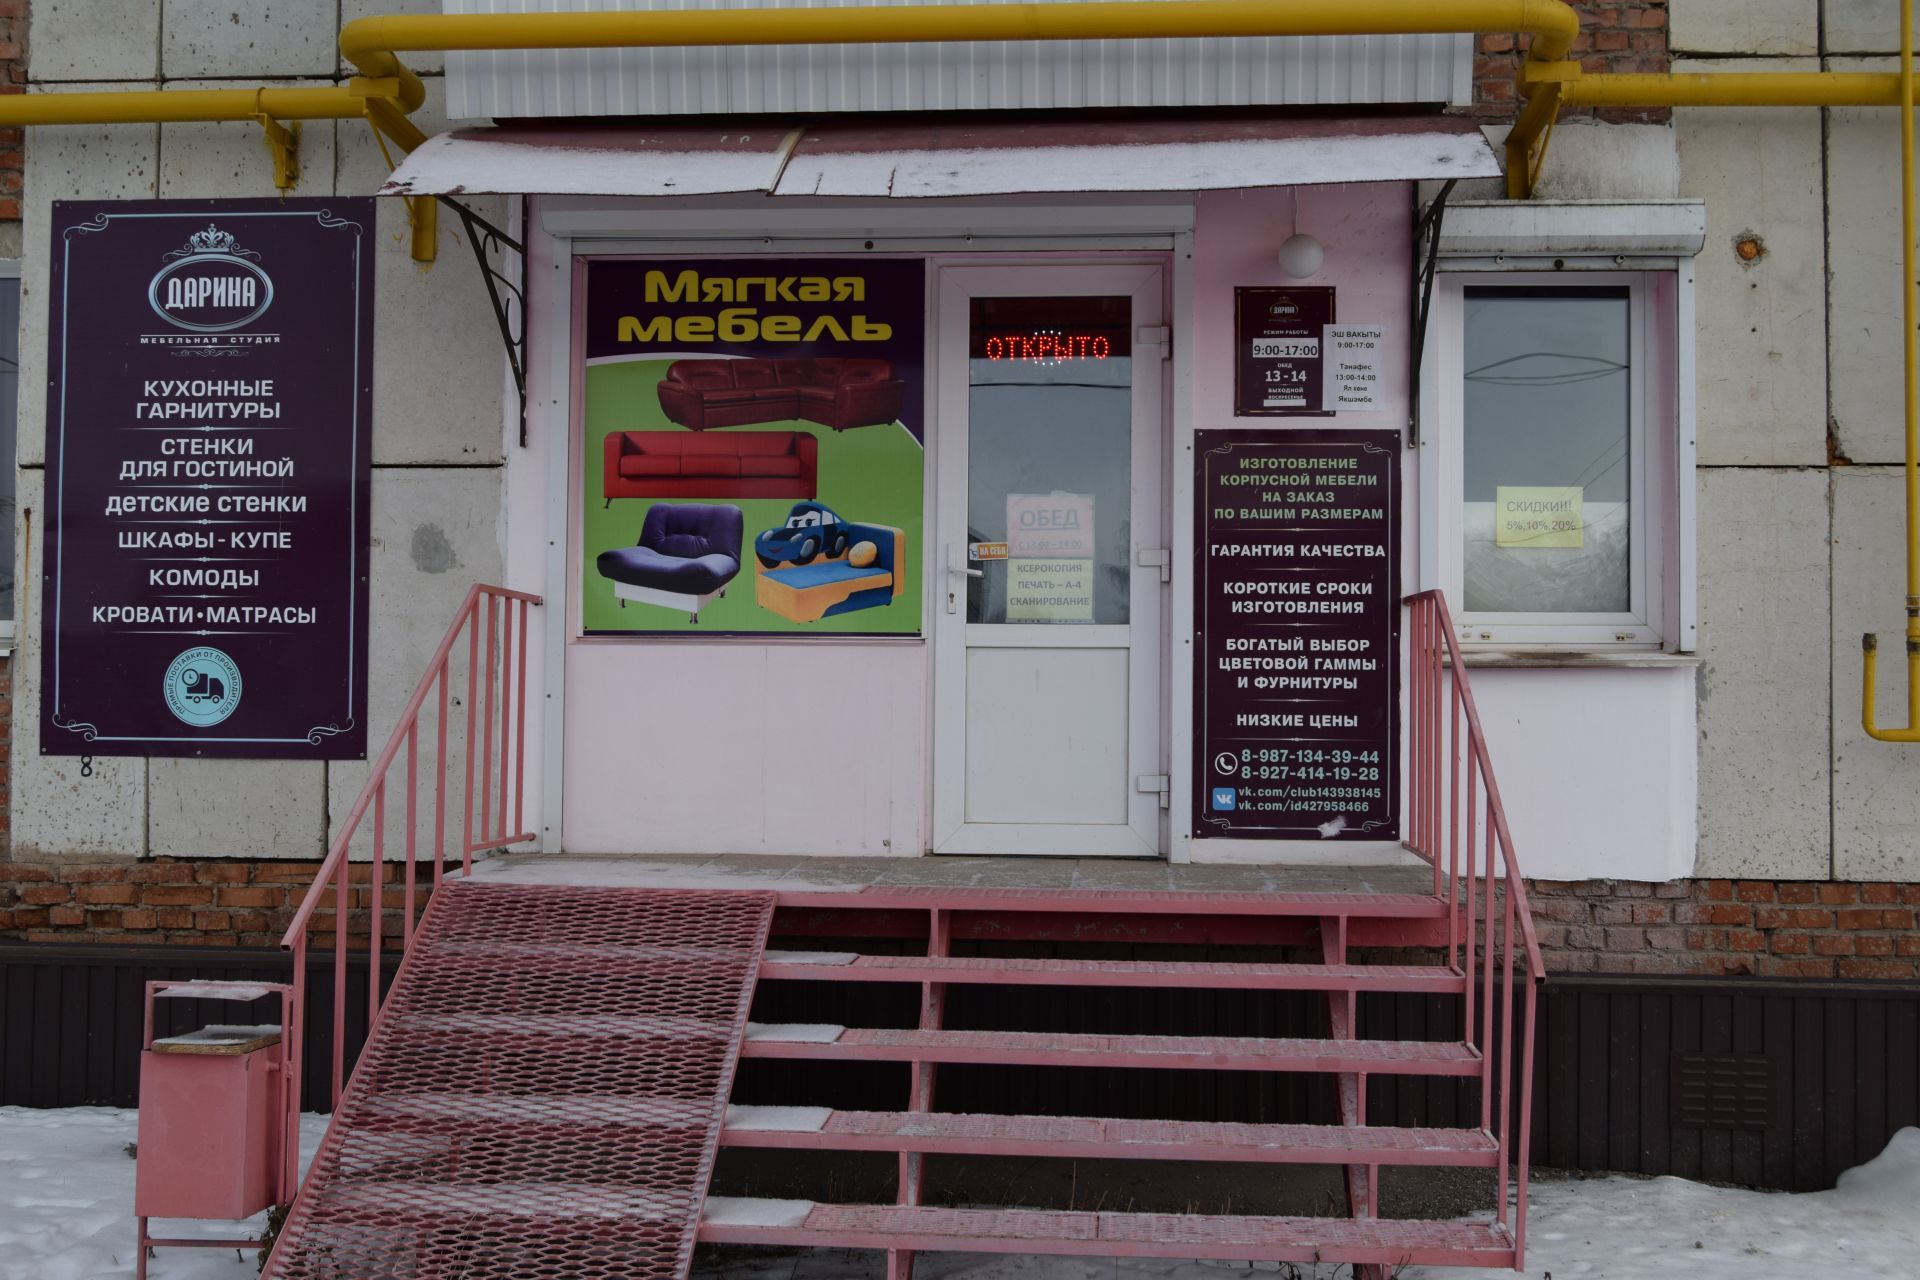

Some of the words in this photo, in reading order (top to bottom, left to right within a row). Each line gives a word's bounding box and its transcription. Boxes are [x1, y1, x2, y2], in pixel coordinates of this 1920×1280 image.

[165, 277, 255, 309] ДАРИНА
[645, 270, 865, 303] Мягкая
[617, 308, 893, 342] мебель
[230, 336, 280, 344] СТУДИЯ
[987, 336, 1109, 360] ОТКРЫТО
[1254, 345, 1318, 356] 9:00-17:00
[1265, 370, 1281, 382] 13
[1291, 370, 1307, 382] 14
[144, 380, 273, 397] КУХОННЫЕ
[136, 402, 281, 419] ГАРНИТУРЫ
[161, 438, 253, 455] СТЕНКИ
[119, 460, 167, 480] ДЛЯ
[173, 457, 294, 478] ГОСТИНОЙ
[1240, 458, 1358, 469] ИЗГОТОВЛЕНИЕ
[1220, 473, 1310, 485] КОРПУСНОЙ
[1316, 475, 1377, 486] МЕБЕЛИ
[1262, 492, 1282, 502] НА
[1286, 492, 1335, 502] ЗАКАЗ
[105, 496, 210, 516] детские
[217, 496, 307, 512] стенки
[1506, 501, 1572, 513] СКИДКИ!!!
[1020, 509, 1080, 529] ОБЕД
[1215, 509, 1235, 519] ПО
[1240, 509, 1296, 519] ВАШИМ
[1301, 509, 1383, 519] РАЗМЕРАМ
[1211, 545, 1294, 556] ГАРАНТИЯ
[1300, 545, 1386, 557] КАЧЕСТВА
[1017, 564, 1082, 573] КСЕРОКОПИЯ
[150, 569, 259, 589] КОМОДЫ
[1018, 581, 1055, 589] ПЕЧАТЬ
[1065, 581, 1081, 589] А-4
[1223, 582, 1311, 594] КОРОТКИЕ
[1316, 582, 1373, 594] СРОКИ
[1010, 597, 1089, 606] СКАНИРОВАНИЕ
[1232, 602, 1364, 613] ИЗГОТОВЛЕНИЯ
[1226, 637, 1303, 651] БОГАТЫЙ
[1310, 639, 1370, 651] ВЫБОР
[169, 652, 202, 682] ПОСТАВКИ
[1219, 656, 1308, 671] ЦВЕТОВОЙ
[1314, 658, 1376, 671] ГАММЫ
[214, 654, 238, 715] ПРОИЗВОДИТЕЛЯ
[1237, 677, 1248, 688] И
[1254, 676, 1358, 689] ФУРНИТУРЫ
[168, 682, 185, 715] ПРЯМЫЕ
[1236, 714, 1304, 726] НИЗКИЕ
[1310, 715, 1358, 729] ЦЕНЫ
[1241, 749, 1379, 763] 8-987-134-39-44
[1241, 766, 1379, 780] 8-927-414-19-28
[1238, 785, 1381, 798] vk.com/club143938145
[1238, 800, 1369, 812] vk.com/id427958466
